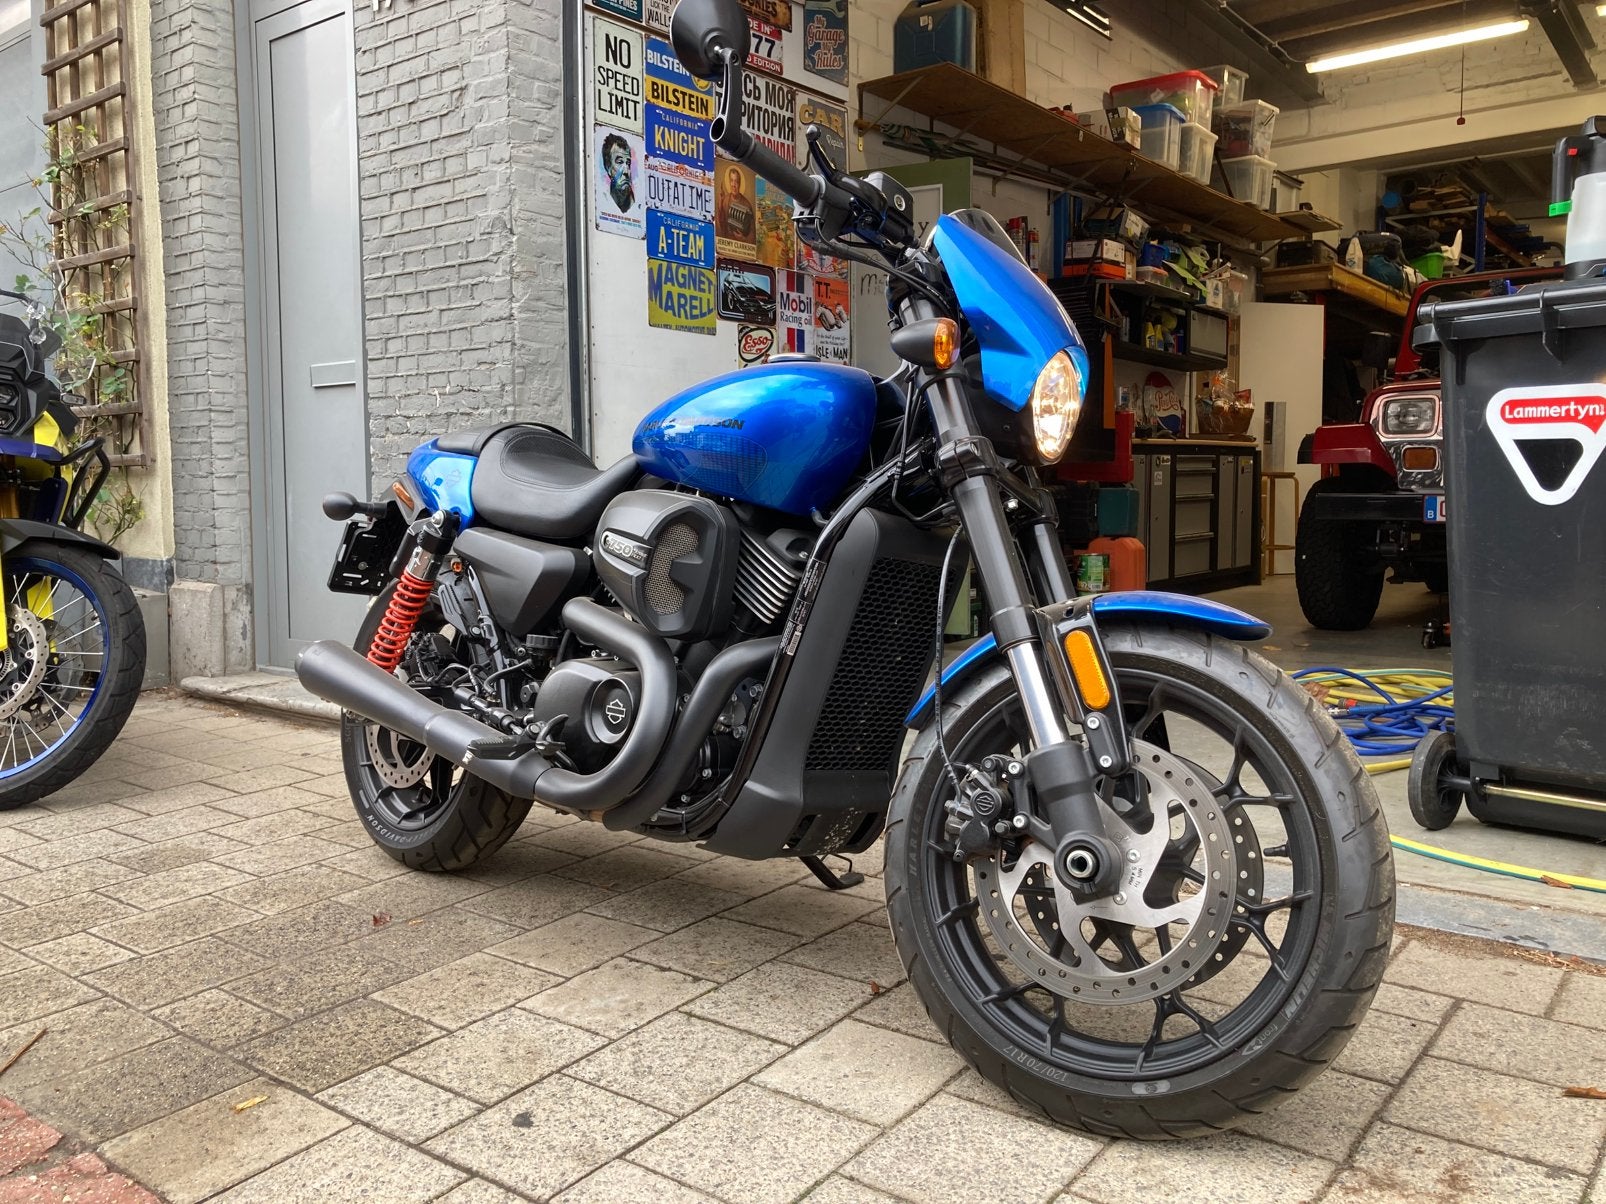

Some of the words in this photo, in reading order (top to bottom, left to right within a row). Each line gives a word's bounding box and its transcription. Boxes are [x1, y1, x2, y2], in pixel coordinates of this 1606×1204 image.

[807, 25, 843, 46] Garage
[605, 33, 631, 69] NO
[815, 51, 842, 68] Rules
[754, 57, 781, 73] EDITION
[598, 65, 639, 97] SPEED
[598, 90, 640, 122] LIMIT
[651, 80, 709, 116] BILSTEIN
[765, 80, 794, 113] МОЯ
[661, 113, 698, 130] CALIFORNIA
[740, 101, 794, 142] РИТОРИЯ
[800, 104, 845, 138] CAR
[655, 124, 705, 160] KNIGHT
[648, 174, 712, 213] OUTATIME
[662, 216, 699, 231] CALIFORNIA
[658, 226, 705, 261] A-TEAM
[780, 292, 812, 314] Mobil
[780, 311, 802, 328] Racing
[804, 317, 812, 326] oil
[743, 334, 769, 352] Esso
[816, 345, 829, 359] ISLE
[833, 346, 848, 360] MAN
[1427, 510, 1434, 519] B
